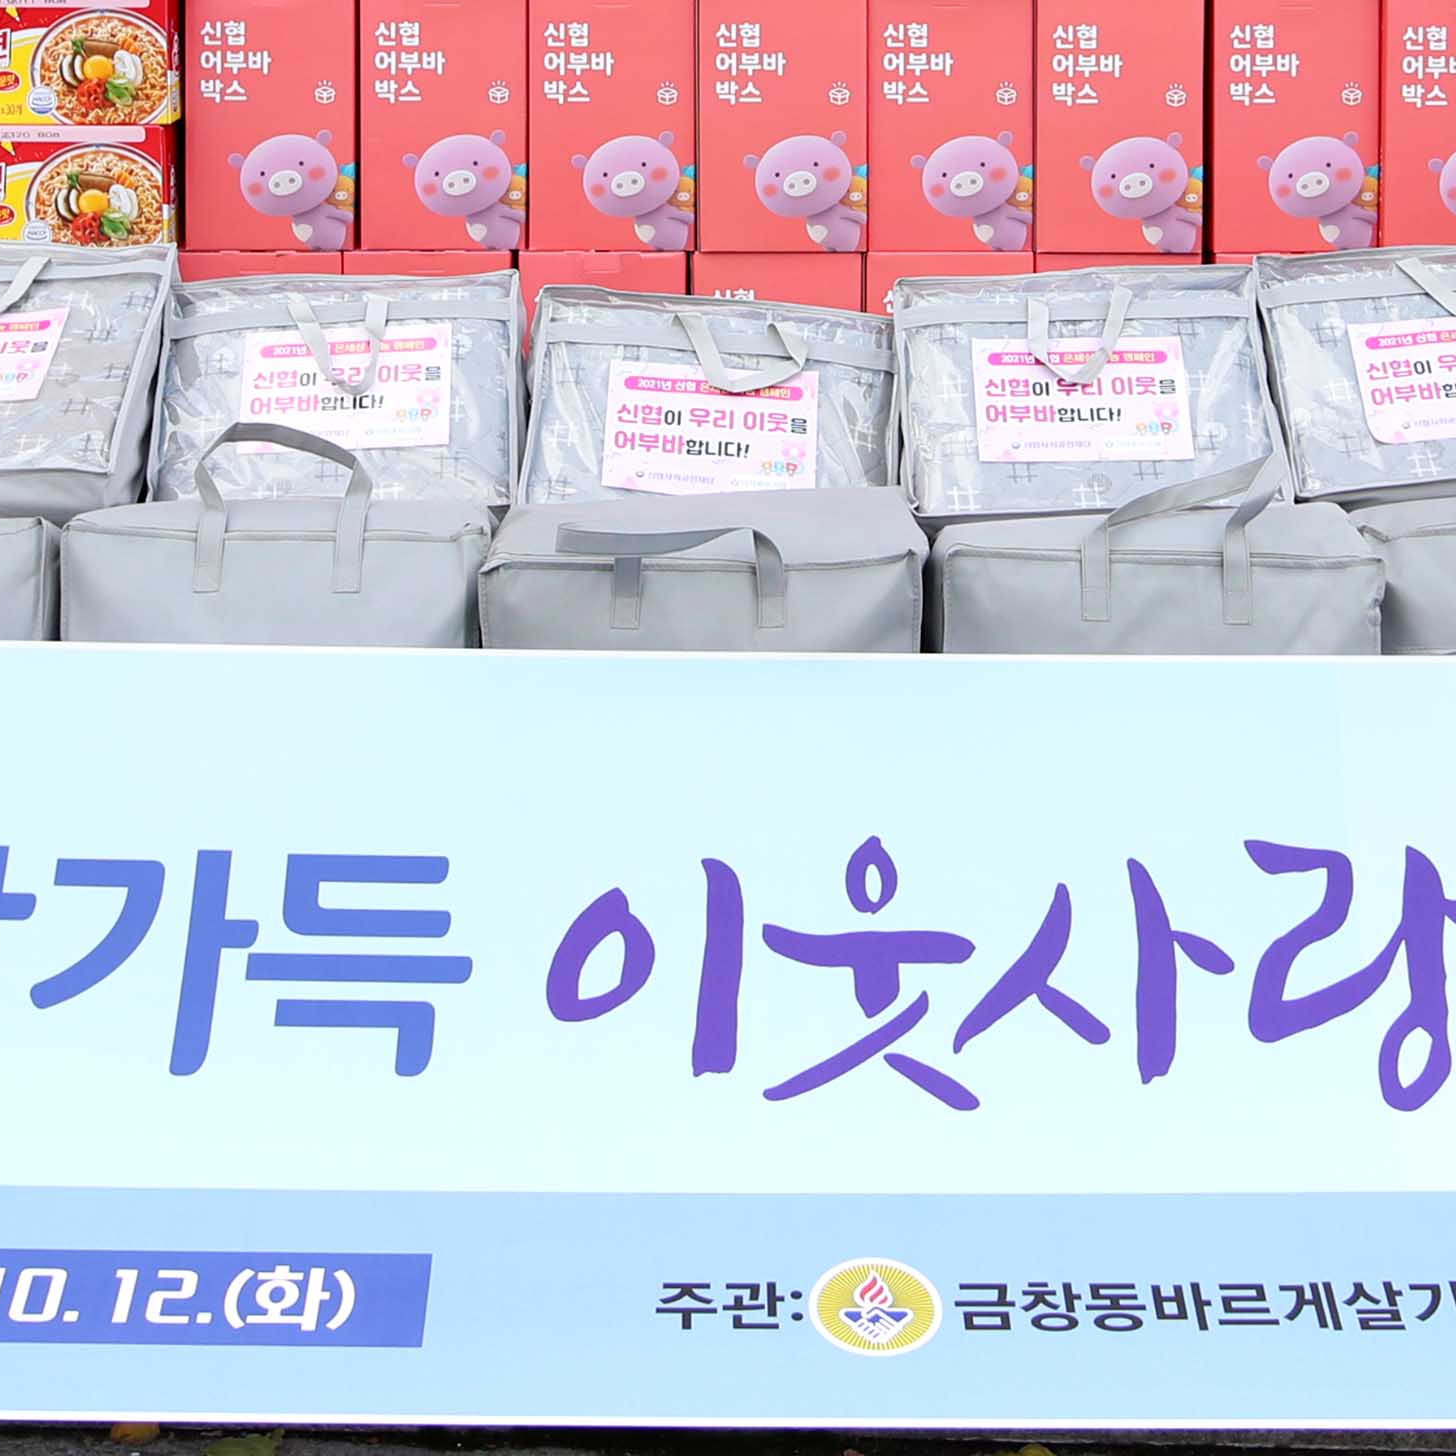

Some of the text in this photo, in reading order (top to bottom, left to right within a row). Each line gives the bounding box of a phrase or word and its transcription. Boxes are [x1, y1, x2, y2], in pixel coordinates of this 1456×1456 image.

[201, 20, 245, 46] 신협
[375, 21, 419, 46] 신협
[544, 22, 588, 47] 신협
[716, 22, 760, 47] 신협
[883, 23, 928, 48] 신협
[1053, 24, 1097, 49] 신협
[1230, 24, 1274, 49] 신협
[1403, 25, 1447, 51] 신협
[201, 50, 272, 75] 어부바
[375, 51, 446, 75] 어부바
[544, 52, 614, 76] 어부바
[715, 52, 787, 76] 어부바
[883, 52, 954, 76] 어부바
[1052, 54, 1123, 78] 어부바
[1230, 53, 1300, 77] 어부바
[200, 79, 247, 103] 박스
[375, 80, 421, 103] 박스
[544, 80, 590, 105] 박스
[716, 81, 762, 105] 박스
[883, 81, 929, 105] 박스
[1052, 82, 1099, 106] 박스
[1230, 82, 1276, 106] 박스
[1402, 84, 1448, 108] 박스
[253, 369, 317, 389] 신협이
[377, 364, 441, 383] 이웃을
[1367, 359, 1432, 380] 신협이
[985, 378, 1050, 397] 신협이
[1111, 376, 1176, 395] 이웃을
[250, 394, 384, 415] 어부바합니다!
[985, 404, 1121, 423] 어부바합니다!
[617, 404, 808, 434] 신협이 우리 이웃을
[614, 431, 750, 458] 어부바합니다!
[111, 1264, 357, 1332] 12.(화)
[655, 1279, 804, 1331] 주관:
